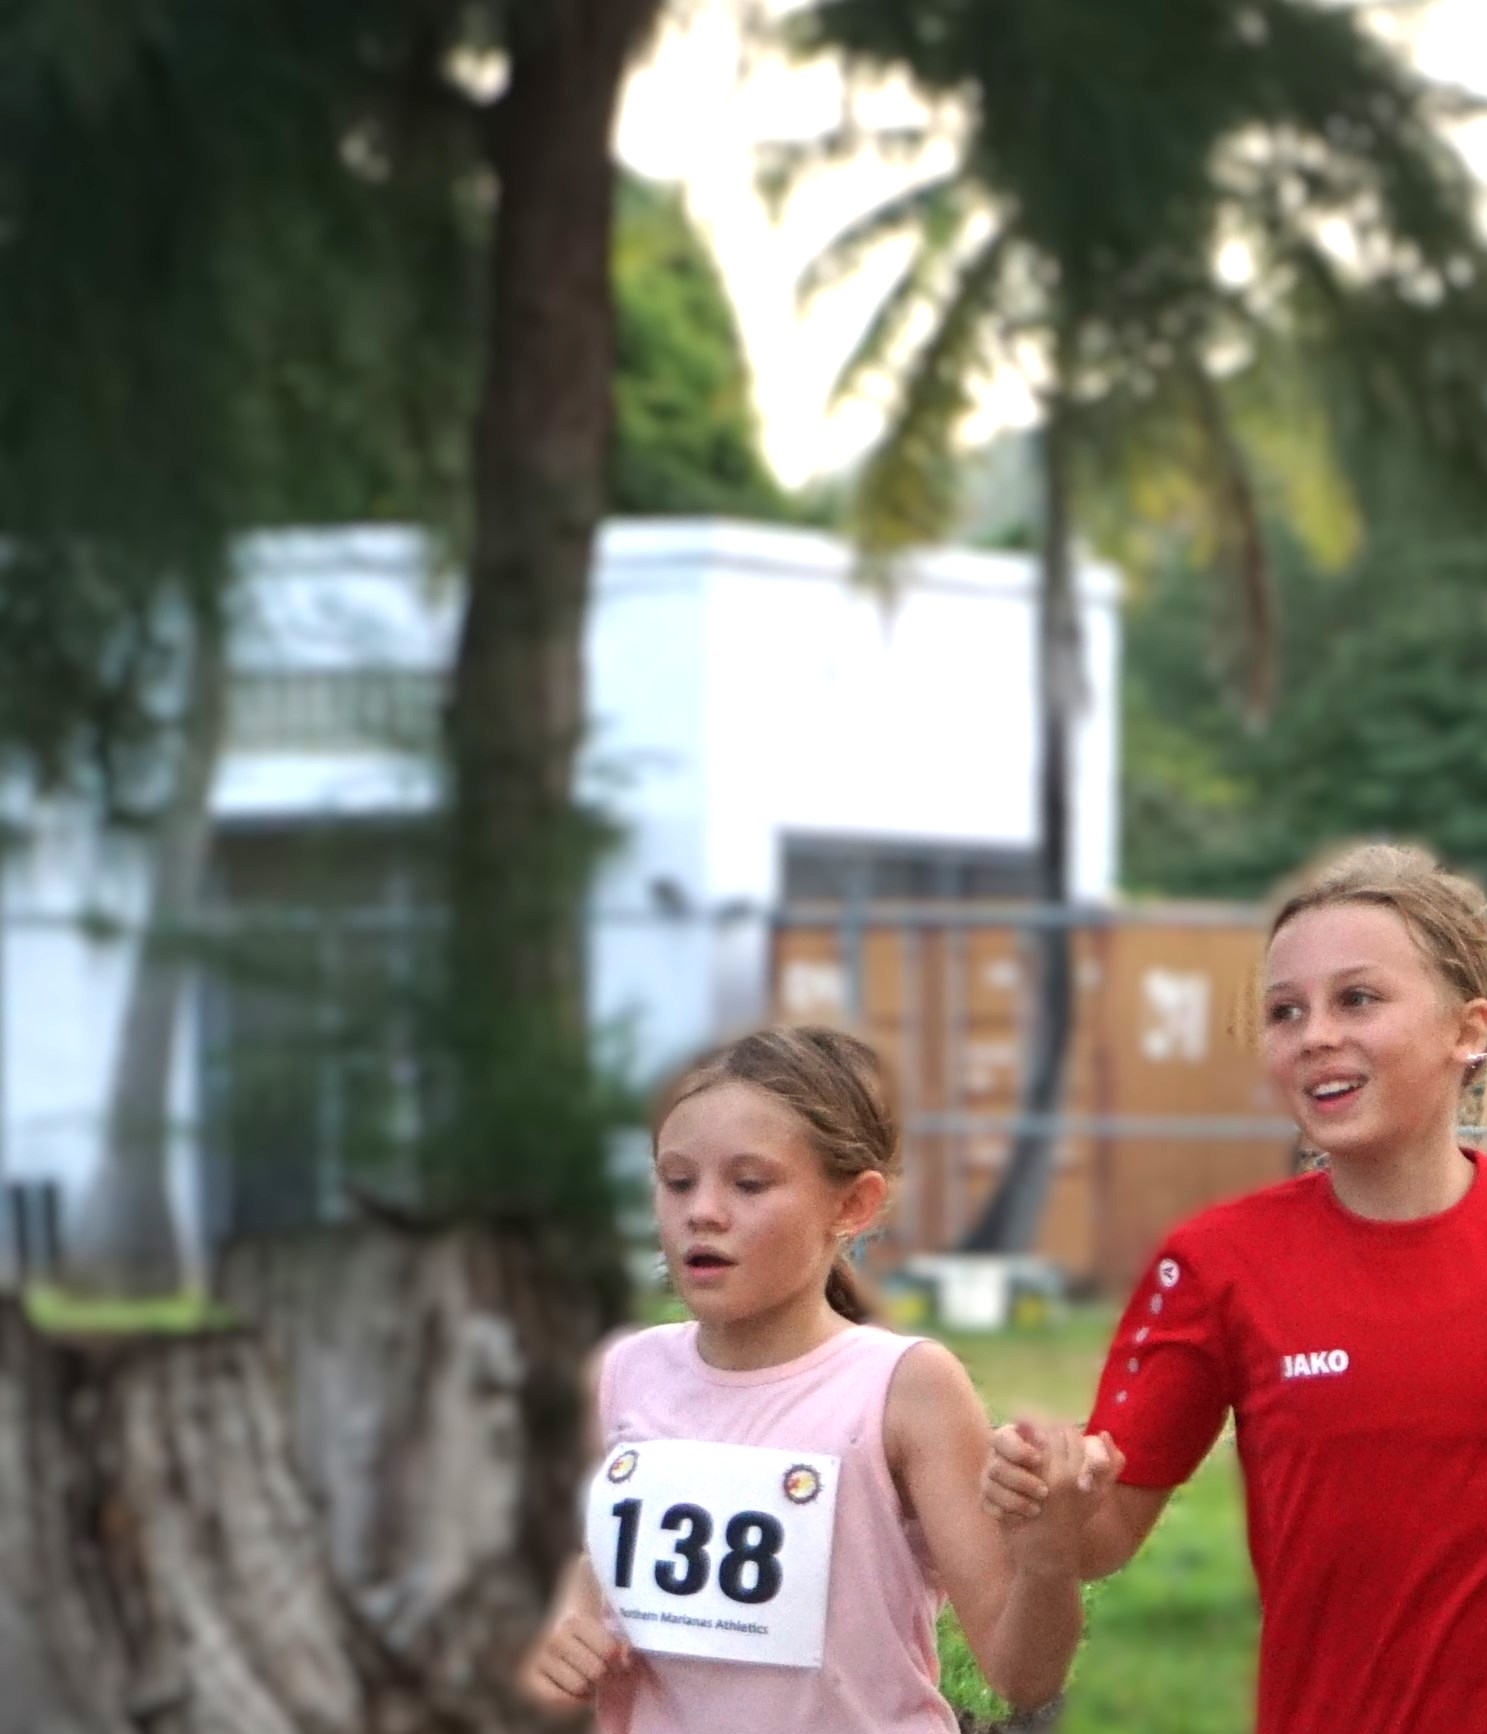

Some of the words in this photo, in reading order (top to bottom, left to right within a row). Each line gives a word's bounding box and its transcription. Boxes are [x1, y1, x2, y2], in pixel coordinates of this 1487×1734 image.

[1283, 1349, 1349, 1378] JAKO
[611, 1497, 785, 1604] 138
[660, 1611, 713, 1629] Marianas
[715, 1618, 769, 1635] Athletics
